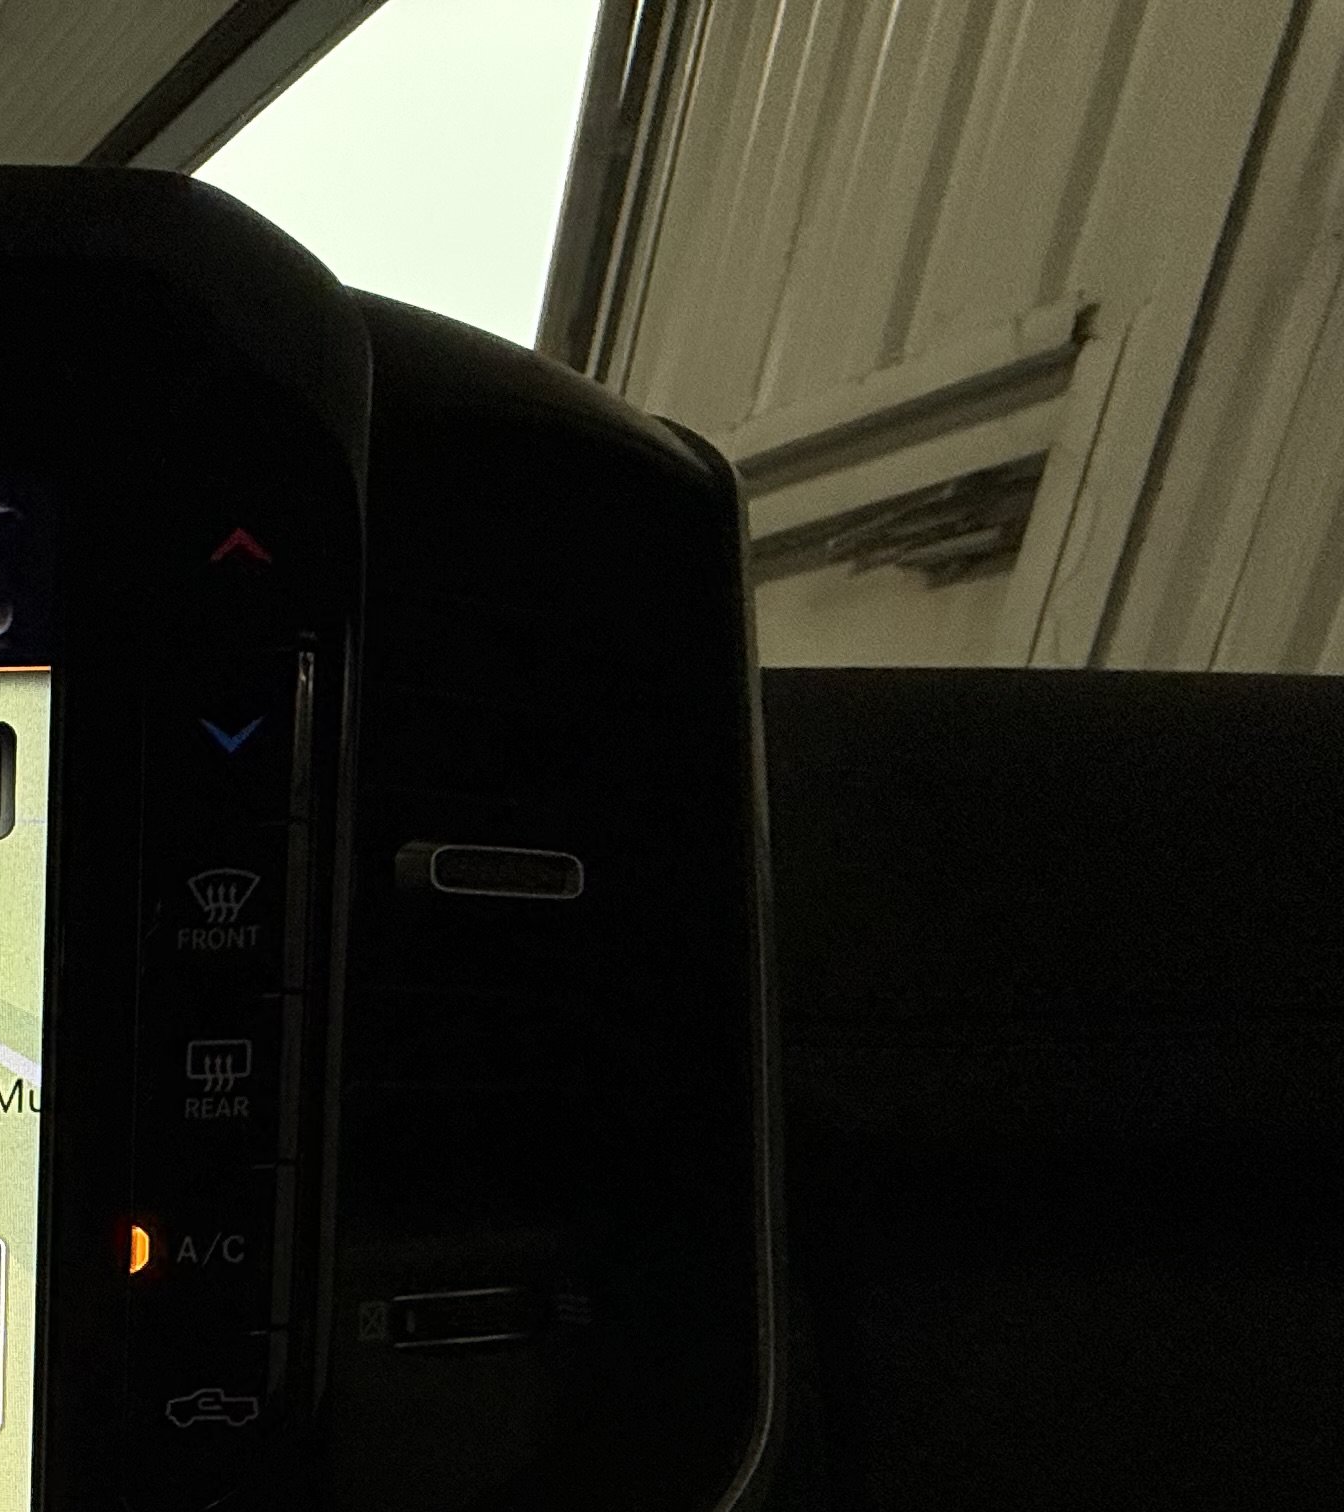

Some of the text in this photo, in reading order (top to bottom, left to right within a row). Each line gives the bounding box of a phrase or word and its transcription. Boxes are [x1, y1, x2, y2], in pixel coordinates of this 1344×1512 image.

[176, 925, 261, 952] FRONT
[183, 1096, 250, 1120] REAR
[176, 1231, 246, 1265] A/C
